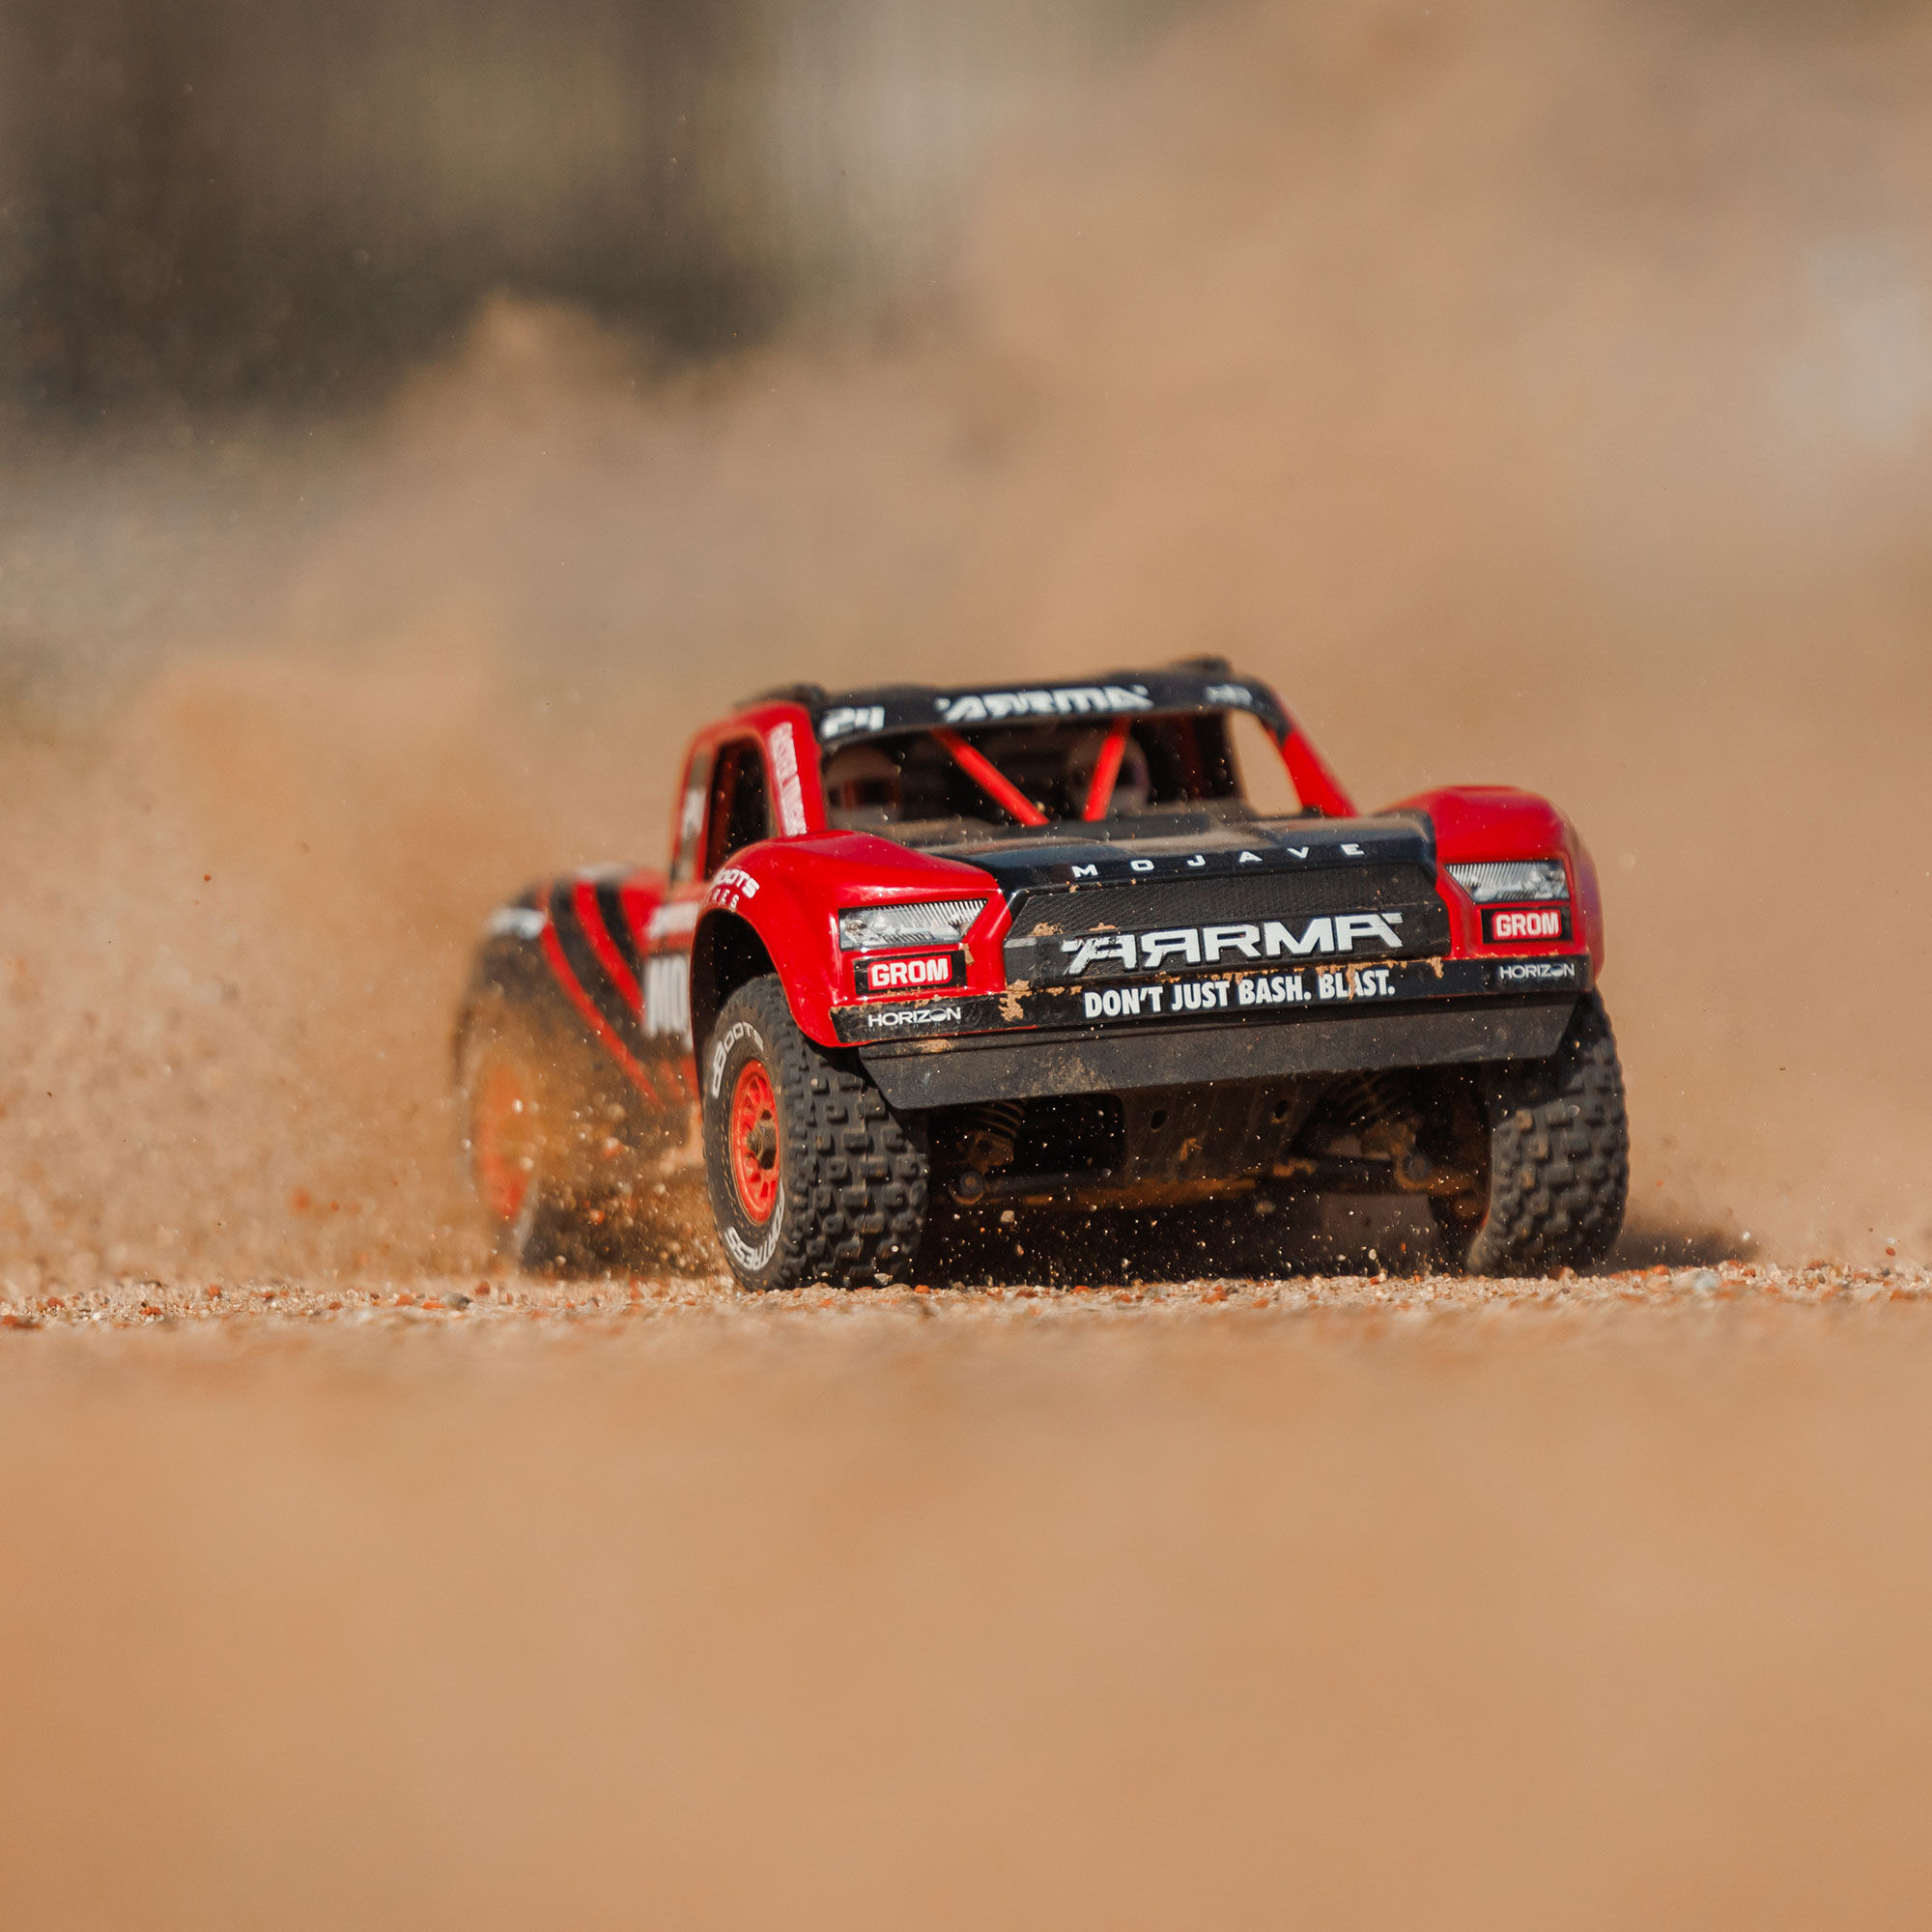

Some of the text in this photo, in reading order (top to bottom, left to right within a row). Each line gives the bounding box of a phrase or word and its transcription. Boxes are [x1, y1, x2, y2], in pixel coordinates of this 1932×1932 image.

[1072, 843, 1364, 878] MOJAVE
[1496, 913, 1559, 936] GROM
[1062, 913, 1403, 976] ARRMA
[871, 958, 949, 986] GROM
[1499, 964, 1575, 979] HORIZON
[1084, 986, 1163, 1018] DON'T
[1172, 981, 1230, 1011] JUST
[1238, 976, 1312, 1006] BASH.
[869, 1007, 962, 1027] HORIZON
